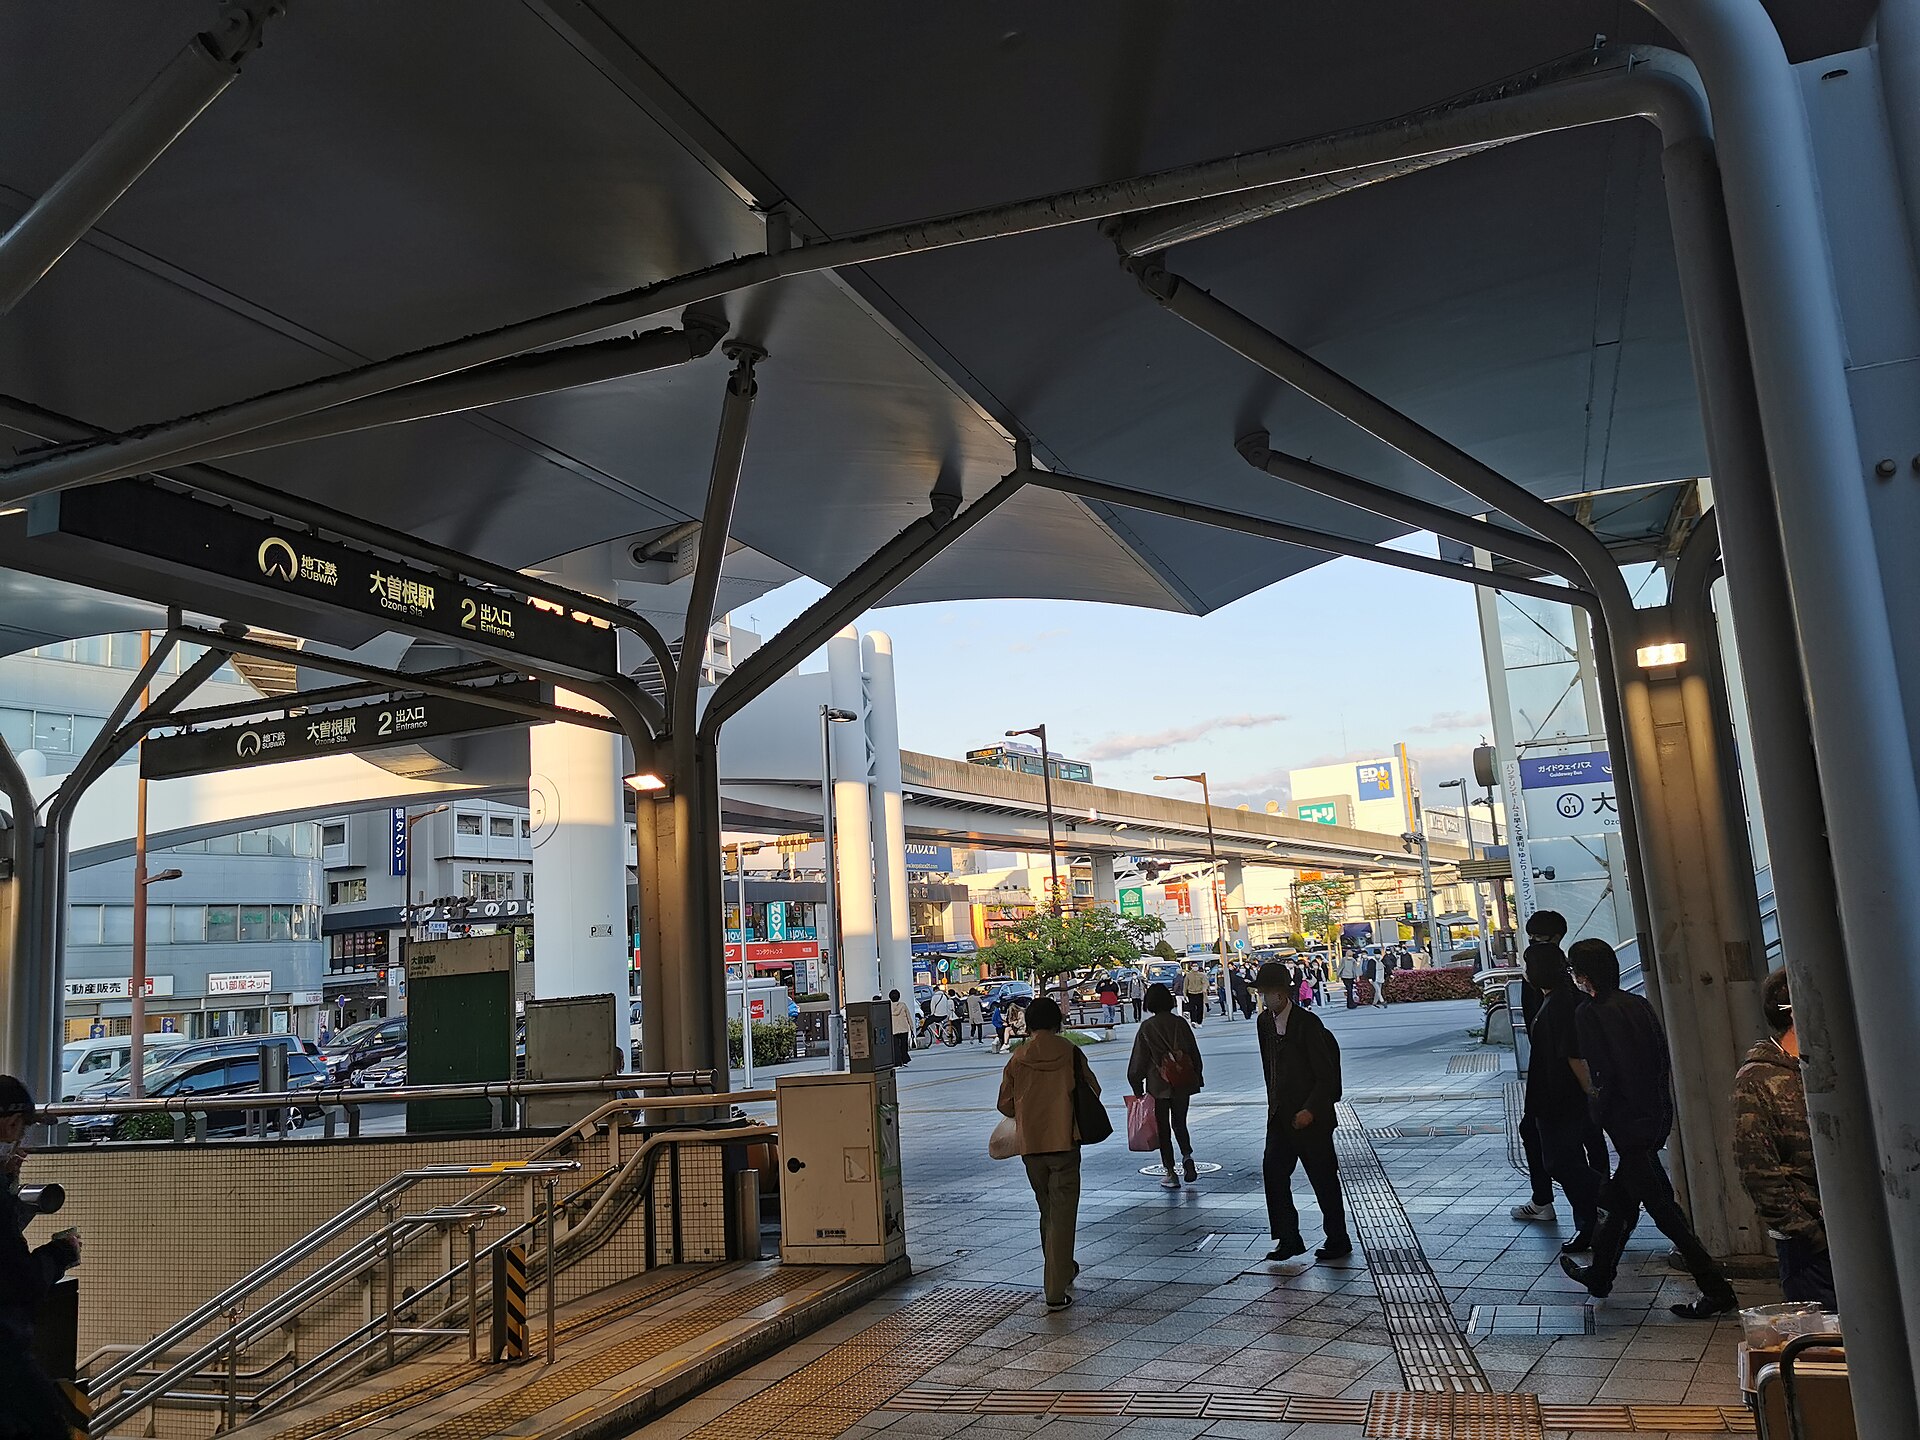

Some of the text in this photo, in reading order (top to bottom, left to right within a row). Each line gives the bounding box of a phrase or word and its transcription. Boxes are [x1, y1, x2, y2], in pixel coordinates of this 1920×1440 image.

[301, 554, 337, 577] 地下鉄
[300, 568, 338, 587] SUBWAY
[369, 570, 435, 611] 大曽根駅
[380, 597, 425, 618] Ozone Sta.
[461, 598, 476, 630] 2
[480, 603, 512, 628] 出入口
[480, 622, 515, 640] Entrance
[378, 711, 392, 736] 2
[395, 706, 425, 723] 出入口
[306, 716, 356, 741] 大曽根駅
[395, 719, 428, 732] Entrance
[261, 738, 286, 750] SUBWAY
[262, 731, 286, 743] 地下鉄
[314, 735, 348, 747] Ozone Sta.
[1538, 761, 1592, 773] ガイドウェイバス
[1563, 804, 1577, 814] 01
[1591, 791, 1618, 815] 大
[1300, 806, 1334, 824] ニトリ
[771, 903, 782, 940] NOVA
[210, 979, 270, 992] いい部屋ネット
